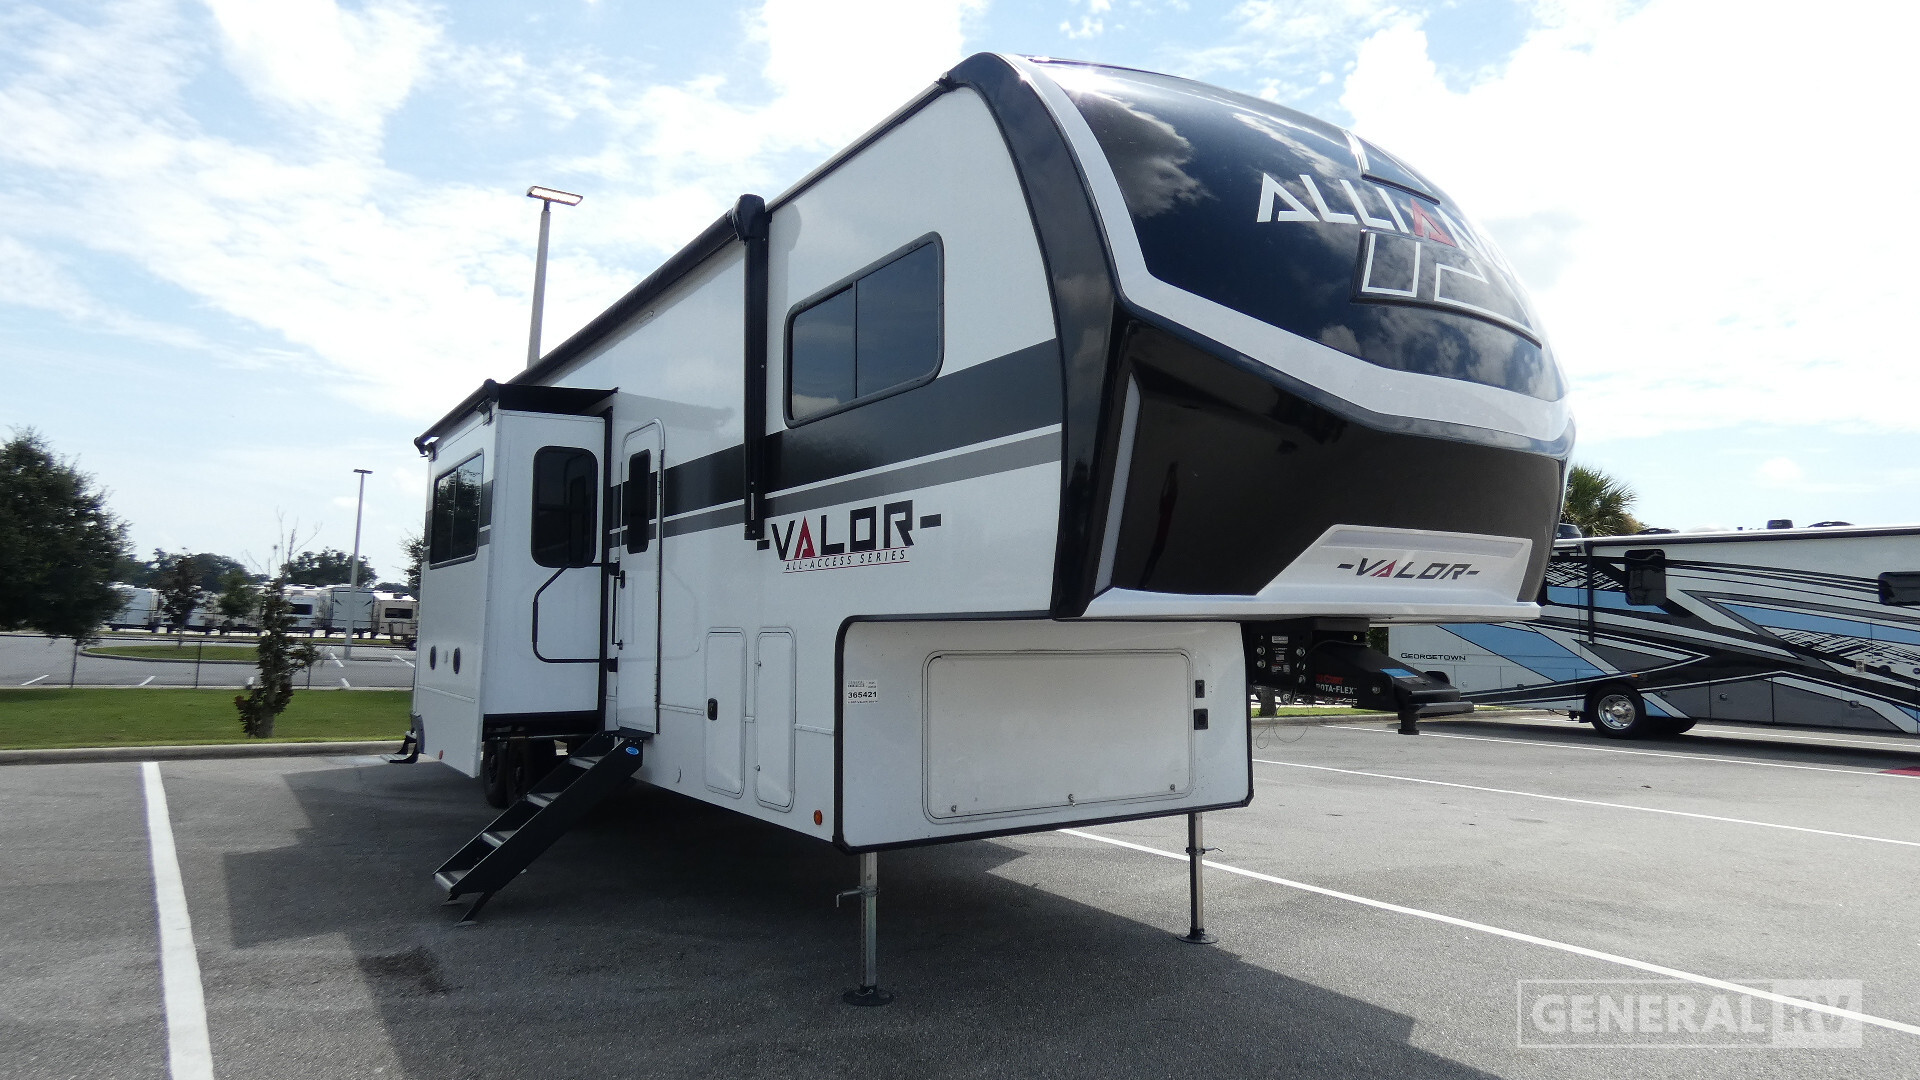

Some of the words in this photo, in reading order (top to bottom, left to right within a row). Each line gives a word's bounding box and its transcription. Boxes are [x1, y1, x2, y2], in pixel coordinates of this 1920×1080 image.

[785, 555, 852, 571] ALL-ACCESS
[859, 549, 906, 564] SERIES
[1400, 652, 1466, 661] GEORGETOWN
[847, 691, 877, 699] 365421
